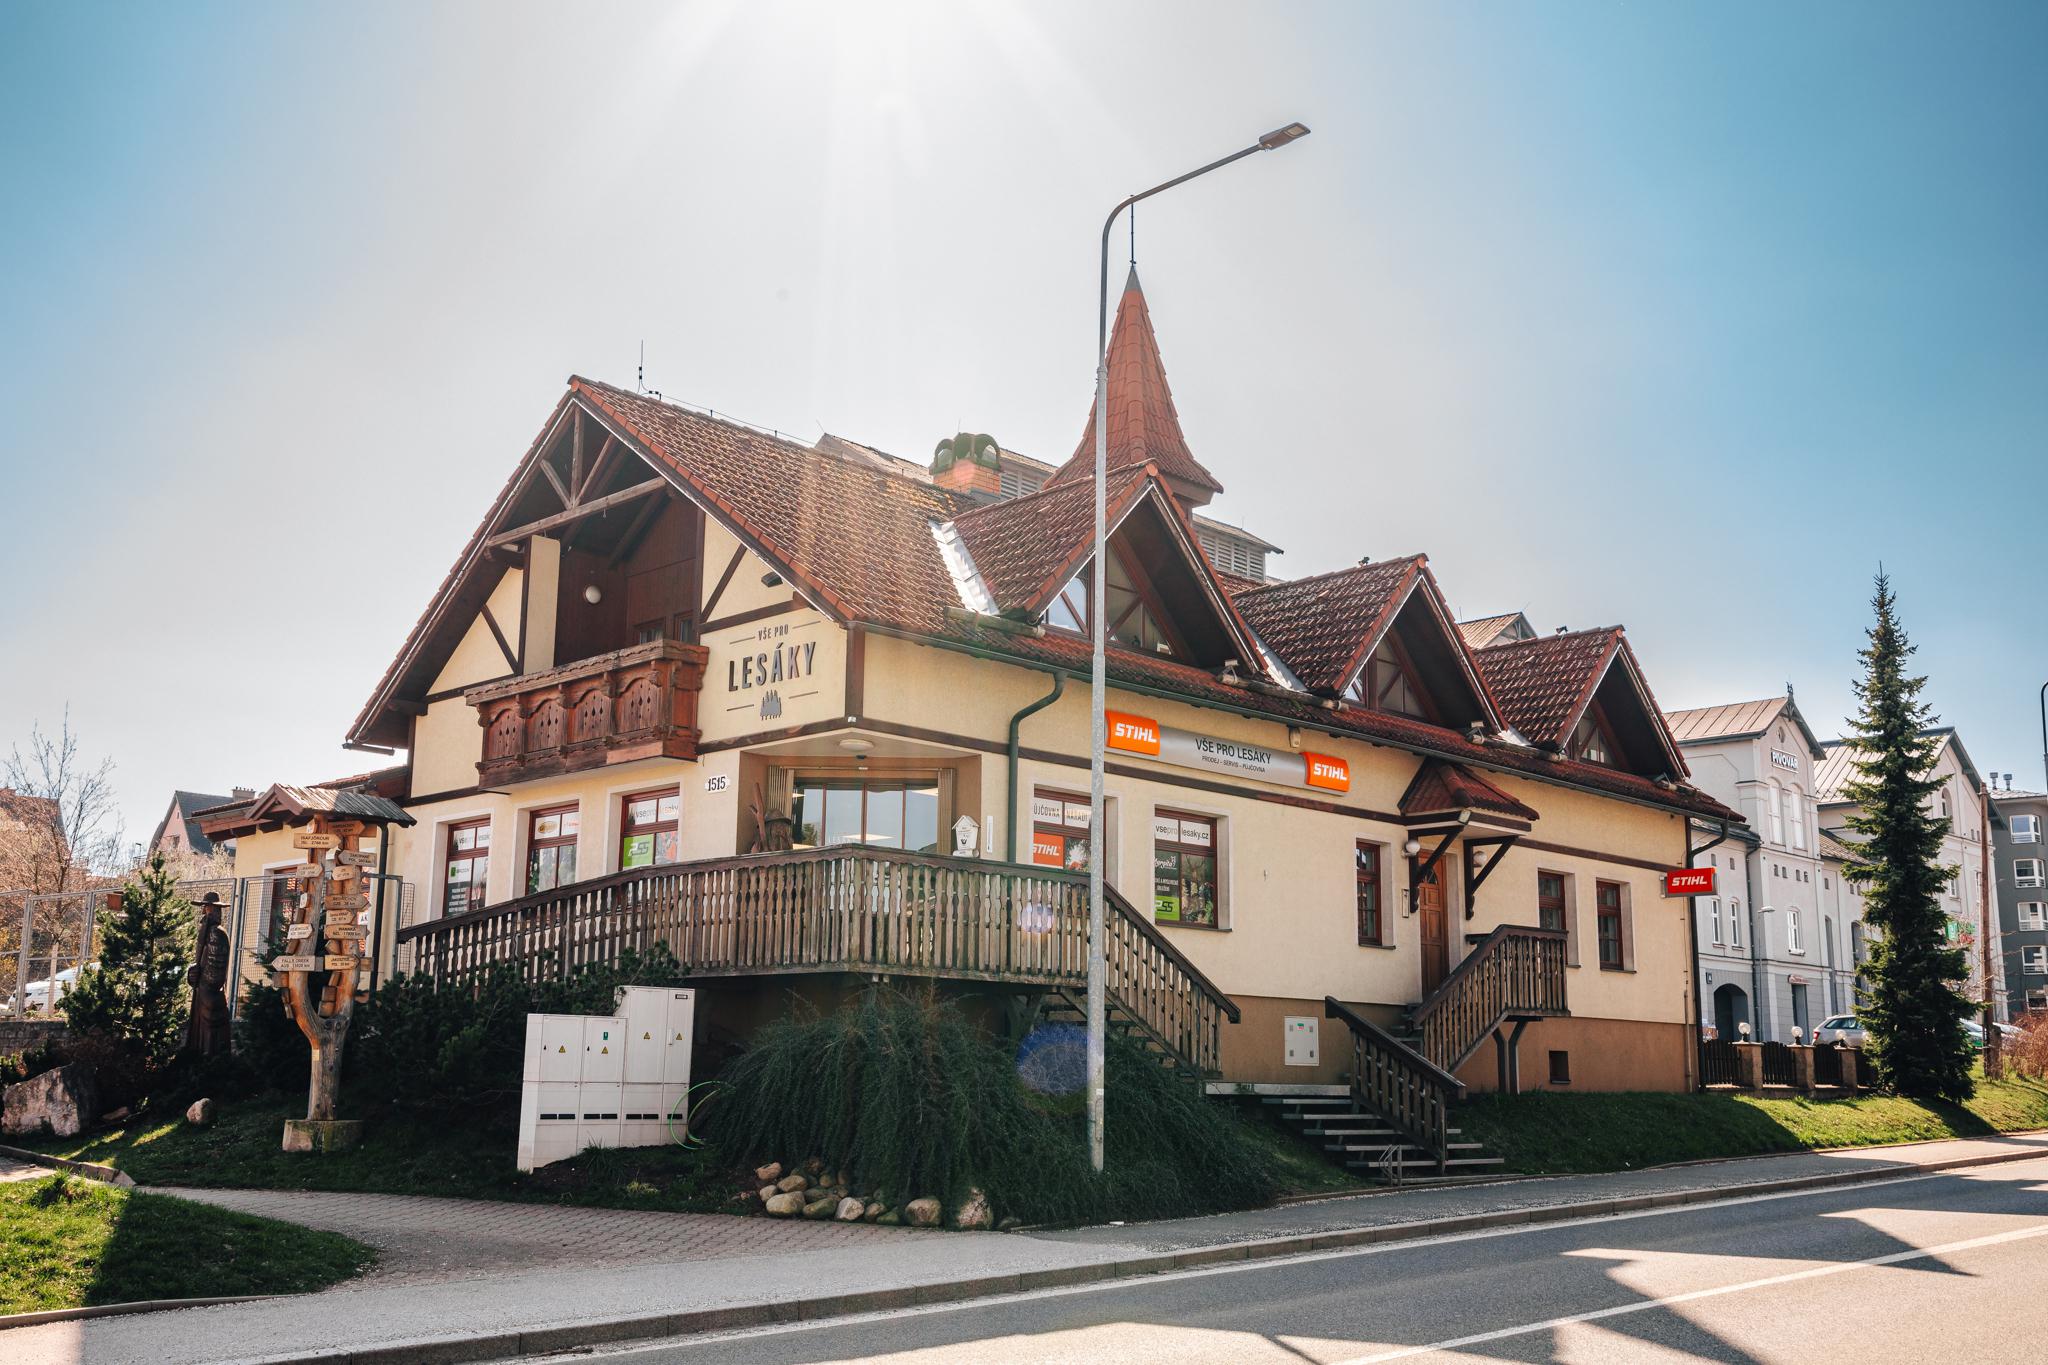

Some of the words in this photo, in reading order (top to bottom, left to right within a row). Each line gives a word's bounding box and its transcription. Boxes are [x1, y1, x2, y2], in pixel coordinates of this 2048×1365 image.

[758, 626, 772, 641] VŠE
[774, 624, 789, 637] PRO
[728, 642, 816, 692] LESÁKY
[1115, 722, 1157, 743] STIHL
[1195, 738, 1214, 753] VŠE
[1216, 743, 1235, 757] PRO
[1237, 747, 1272, 764] LESÁKY
[1202, 755, 1220, 764] PRODEJ
[1313, 762, 1348, 781] STIHL
[708, 776, 726, 791] 1515
[1033, 843, 1060, 856] STIHL
[1671, 876, 1708, 887] STIHL
